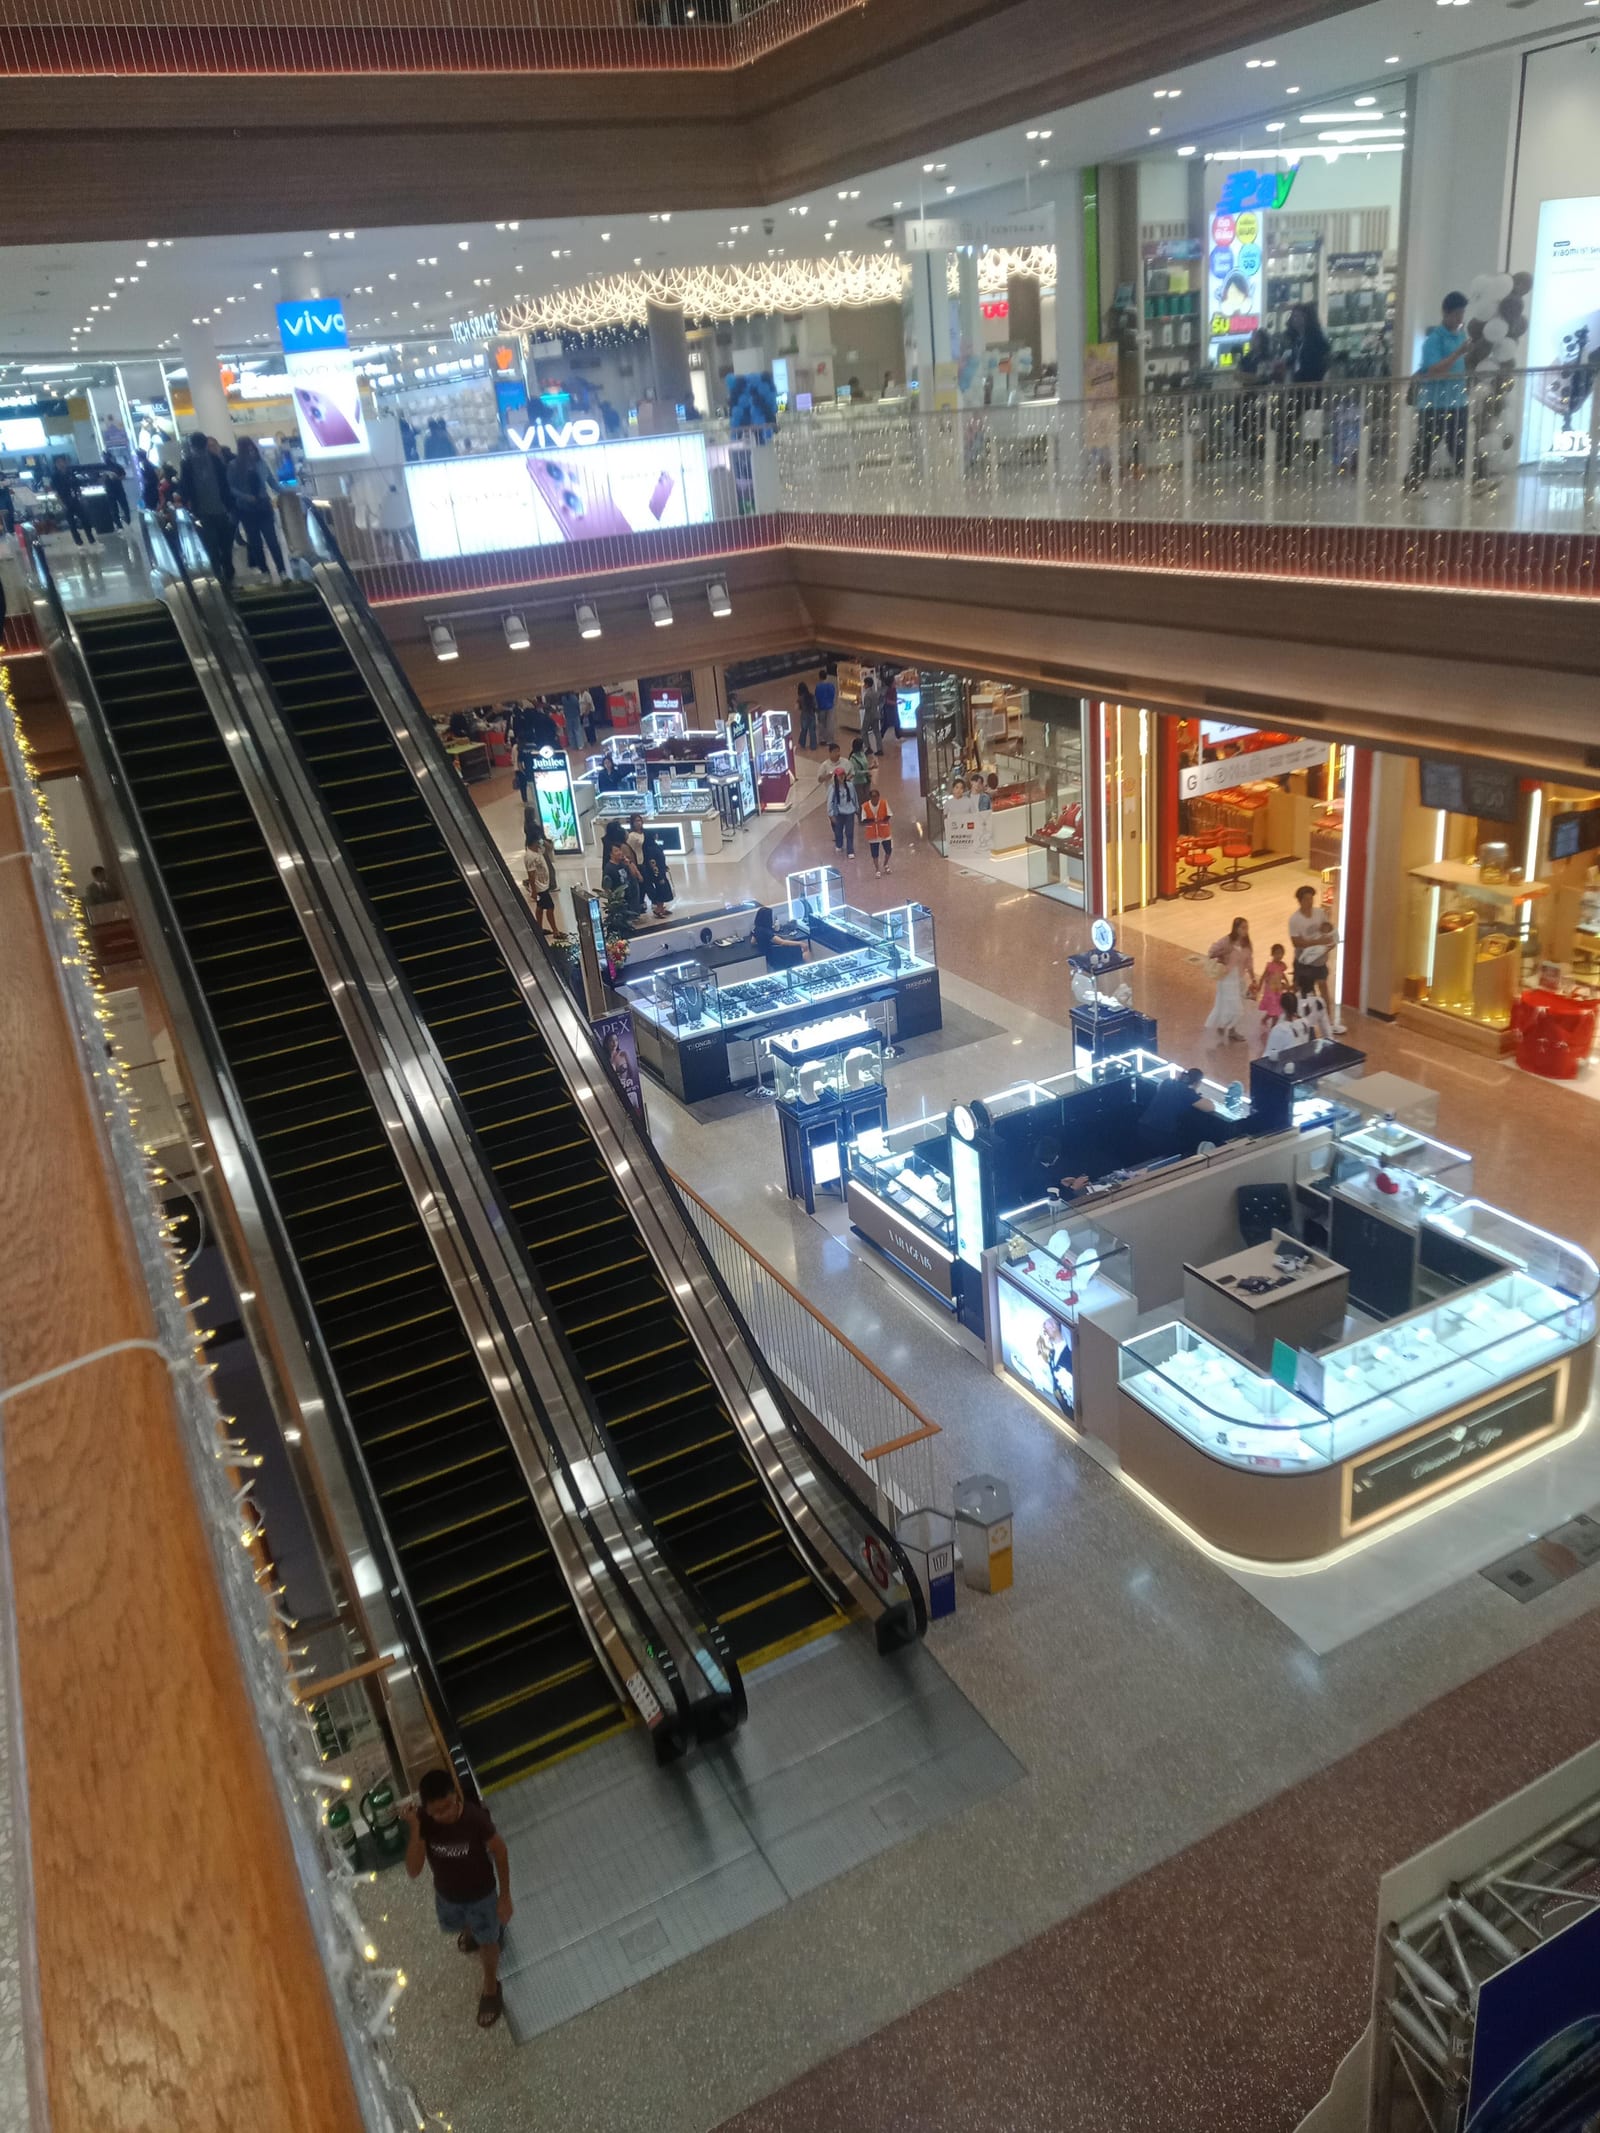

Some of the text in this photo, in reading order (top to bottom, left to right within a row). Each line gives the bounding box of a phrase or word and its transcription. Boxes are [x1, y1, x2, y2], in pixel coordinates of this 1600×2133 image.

[1217, 164, 1299, 216] Pay
[283, 310, 346, 336] vivo
[507, 417, 600, 452] vivo
[532, 758, 565, 770] Jubilee
[1186, 775, 1198, 791] G
